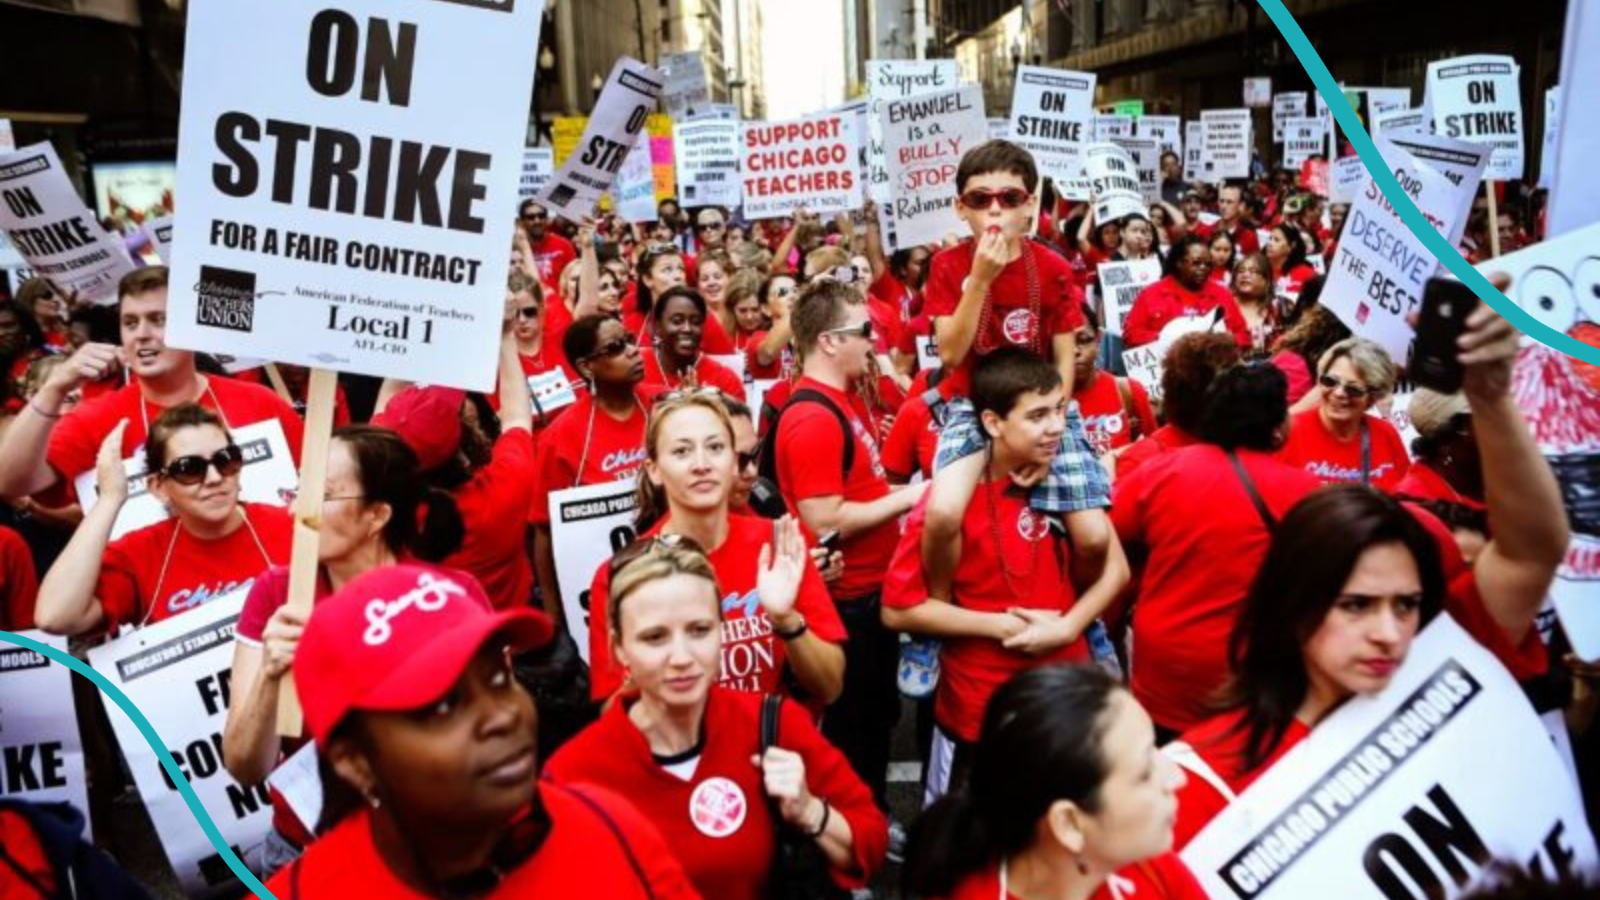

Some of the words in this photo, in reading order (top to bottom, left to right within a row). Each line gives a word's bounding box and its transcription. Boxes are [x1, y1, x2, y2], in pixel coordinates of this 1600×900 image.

[306, 8, 417, 107] ON
[879, 63, 945, 95] Support
[1467, 80, 1496, 104] ON
[888, 92, 972, 124] EMANUEL
[1040, 91, 1066, 112] ON
[745, 117, 842, 148] SUPPORT
[1017, 116, 1083, 141] STRIKE
[1445, 111, 1517, 138] STRIKE
[747, 143, 847, 172] CHICAGO
[897, 135, 963, 164] BULLY
[211, 110, 492, 234] STRIKE
[743, 170, 853, 196] TEACHERS
[905, 165, 958, 190] STOP
[1394, 169, 1422, 200] OUR
[2, 186, 45, 218] ON
[9, 216, 97, 257] STRIKE
[1350, 210, 1429, 284] DESERVE
[210, 219, 256, 251] FOR
[262, 228, 279, 255] A
[284, 231, 339, 265] FAIR
[345, 241, 481, 286] CONTRACT
[1340, 249, 1366, 279] THE
[1367, 271, 1418, 317] BEST
[199, 295, 254, 313] TEACHERS
[199, 306, 251, 328] UNION
[293, 285, 347, 303] American
[350, 293, 410, 312] Federation
[412, 304, 426, 314] of
[427, 305, 475, 322] Teachers
[326, 305, 410, 340] Local
[422, 319, 434, 344] 1
[353, 339, 407, 355] AFL-CIO
[563, 502, 608, 520] CHICAGO
[184, 630, 218, 653] STAND
[1229, 804, 1328, 895] CHICAGO
[1322, 748, 1393, 818] PUBLIC
[1380, 667, 1472, 758] SCHOOLS
[1362, 783, 1493, 900] ON
